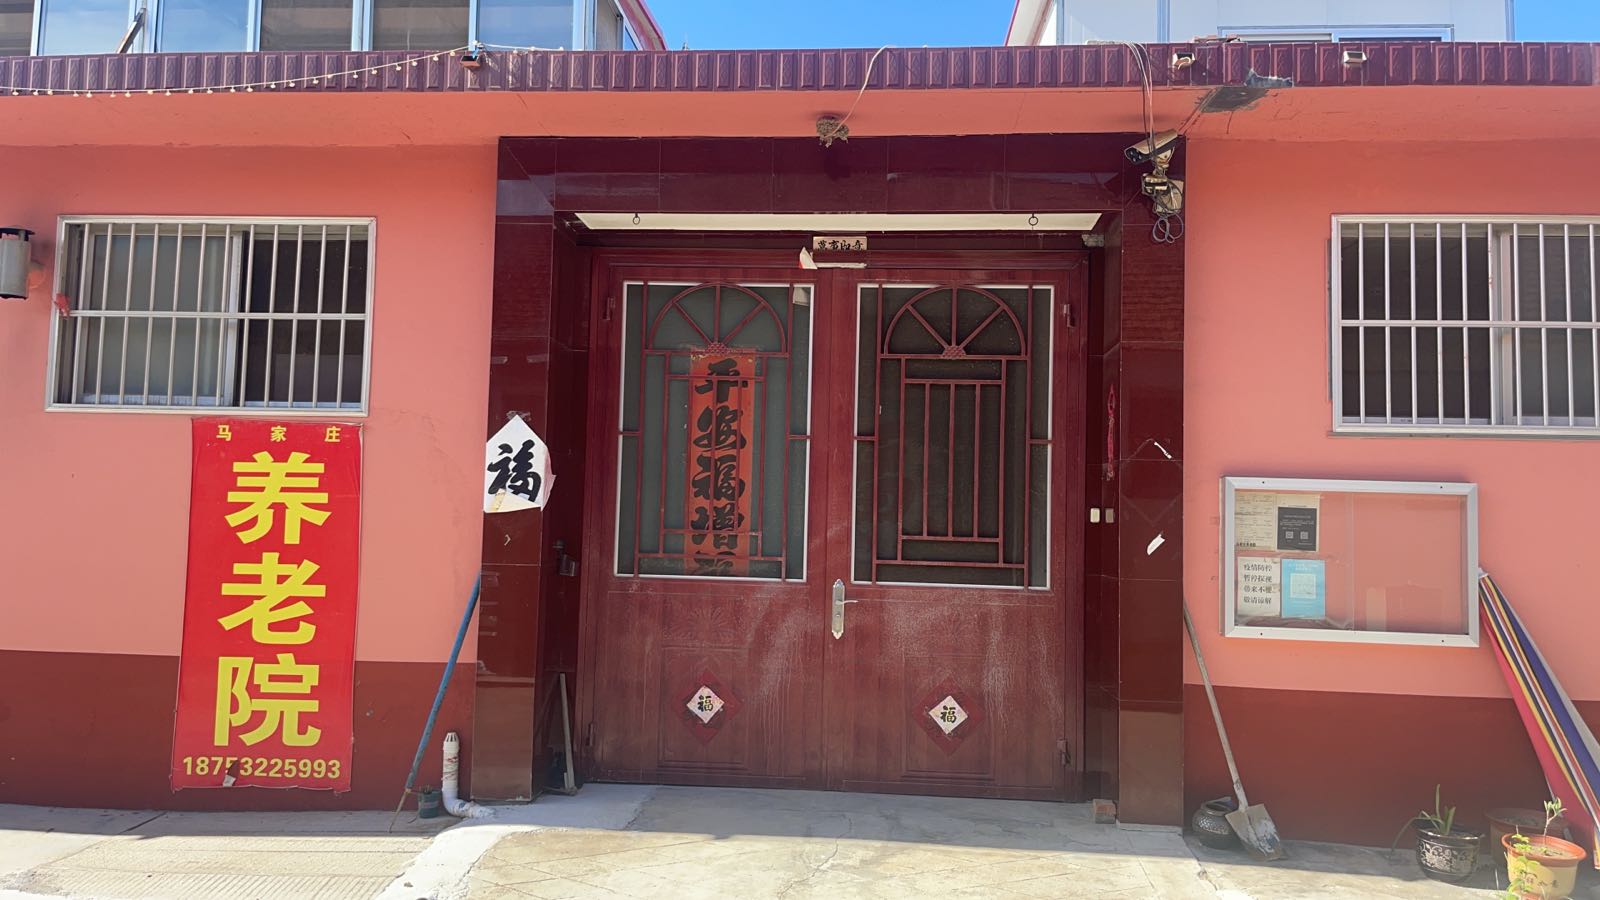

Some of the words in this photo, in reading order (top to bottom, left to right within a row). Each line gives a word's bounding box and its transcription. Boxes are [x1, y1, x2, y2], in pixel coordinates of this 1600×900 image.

[216, 425, 341, 443] 马家庄
[487, 439, 541, 502] 福
[214, 451, 332, 747] 养老院
[698, 695, 713, 712] 福
[940, 705, 957, 723] 福
